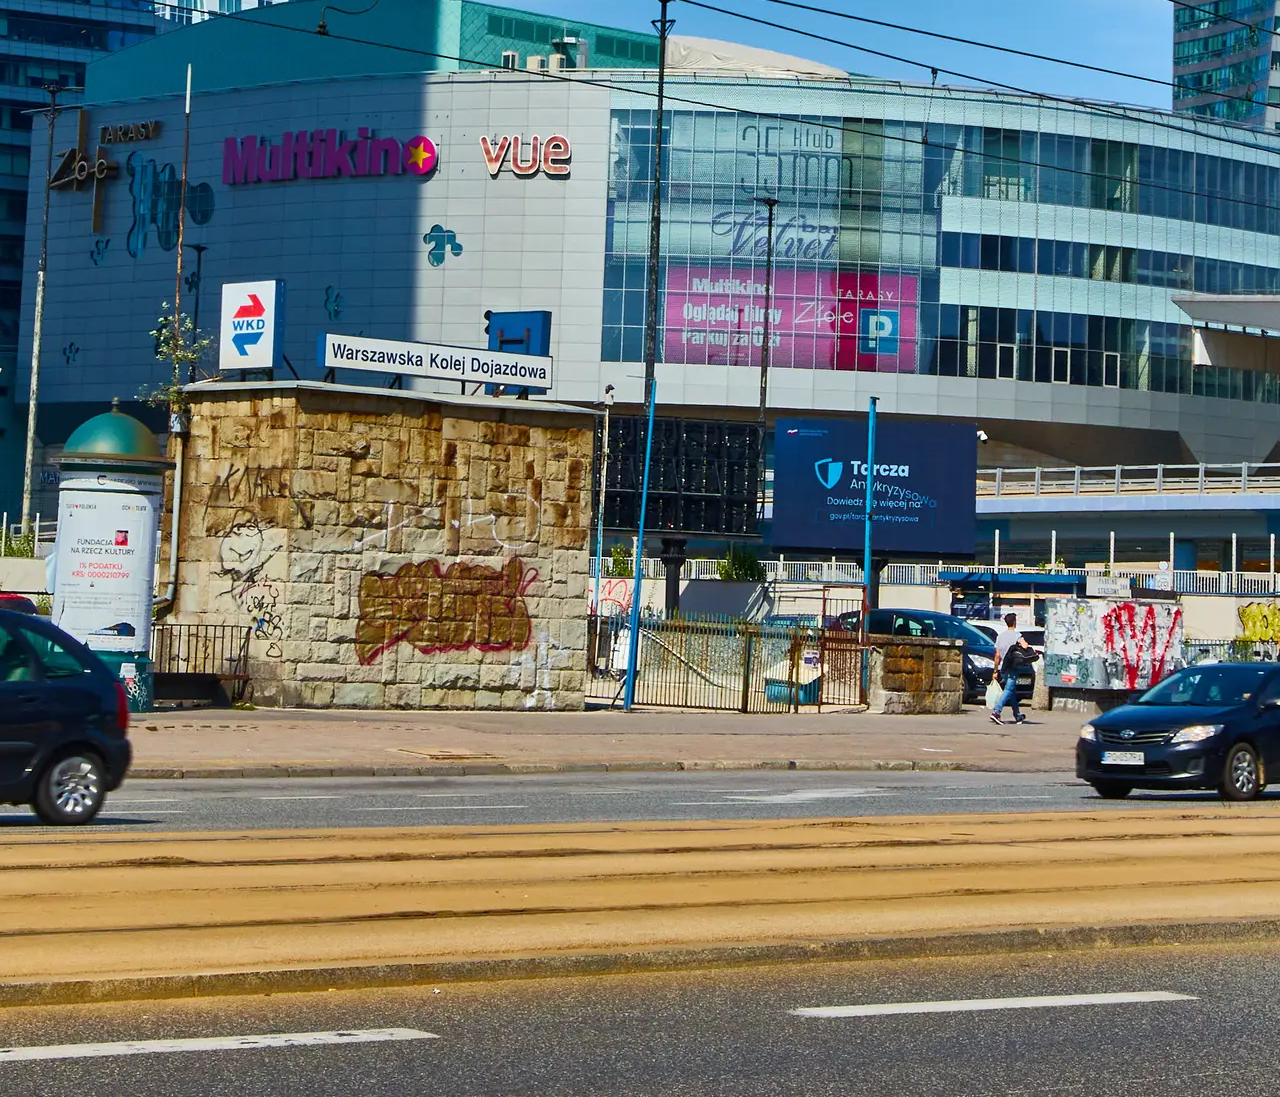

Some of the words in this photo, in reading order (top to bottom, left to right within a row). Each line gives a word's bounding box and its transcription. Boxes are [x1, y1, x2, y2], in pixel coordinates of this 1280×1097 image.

[222, 127, 437, 185] Multikino
[478, 134, 572, 177] vue
[838, 289, 894, 301] TARASY
[683, 302, 739, 324] Oglądaj
[232, 318, 265, 331] WKD
[331, 342, 423, 368] Warszawska
[429, 353, 466, 375] Kolej
[471, 357, 547, 381] Dojazdowa
[850, 460, 910, 478] Tarcza
[850, 479, 937, 508] Anykryzysowa
[826, 496, 863, 506] Dowiedz
[880, 498, 908, 510] więcej
[77, 538, 113, 546] FUNDACJA
[81, 547, 103, 555] RZECZ
[104, 548, 136, 556] KULTURY
[88, 562, 123, 570] PODATKU
